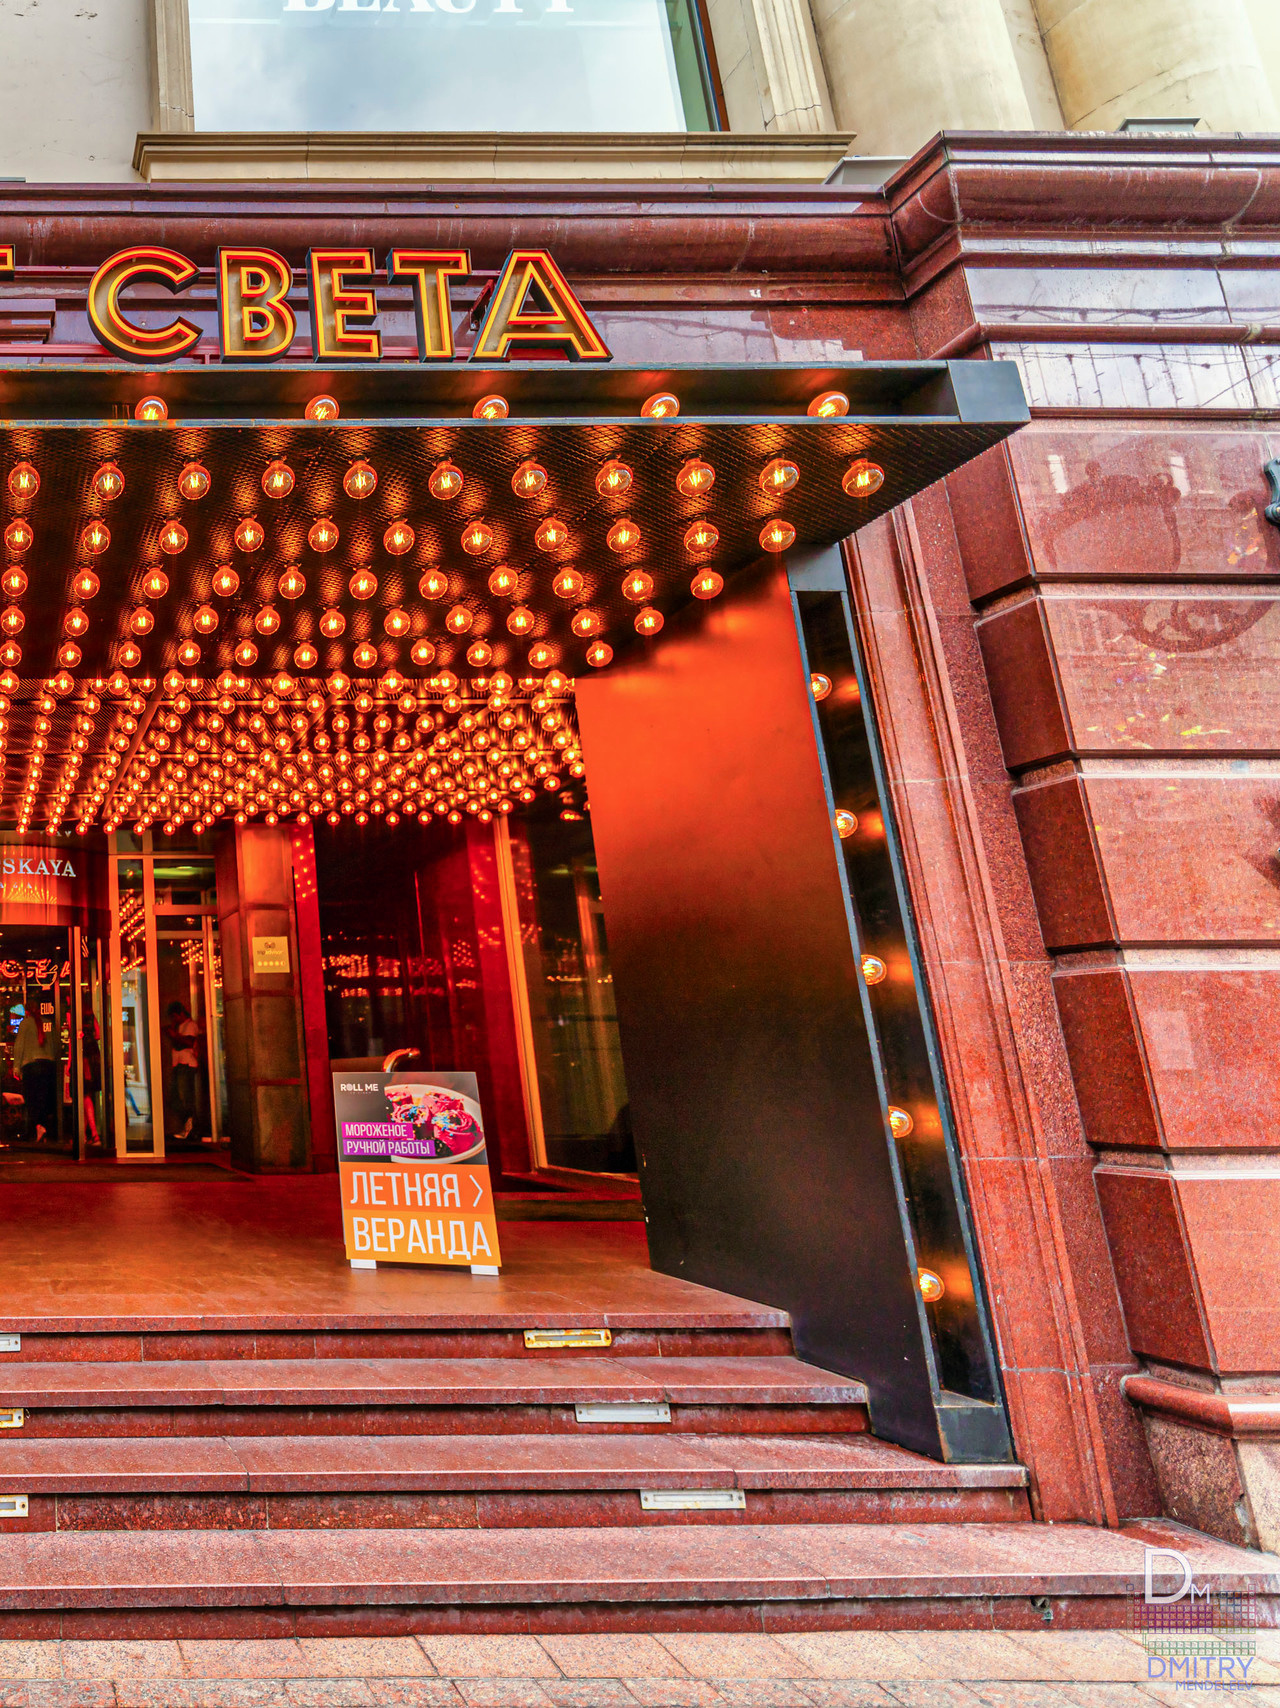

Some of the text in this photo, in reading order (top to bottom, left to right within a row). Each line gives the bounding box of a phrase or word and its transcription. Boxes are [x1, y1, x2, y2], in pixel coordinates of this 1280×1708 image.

[87, 245, 613, 364] СВЕТА
[40, 1002, 54, 1015] ЕШЬ
[43, 1022, 52, 1032] EAT
[340, 1083, 379, 1092] ROLL ME
[345, 1124, 408, 1137] МОРОЖЕНОЕ
[346, 1140, 430, 1155] РУЧНОЙ РАБОТЫ
[350, 1171, 461, 1208] ЛЕТНЯЯ
[352, 1217, 492, 1260] ВЕРАНДА
